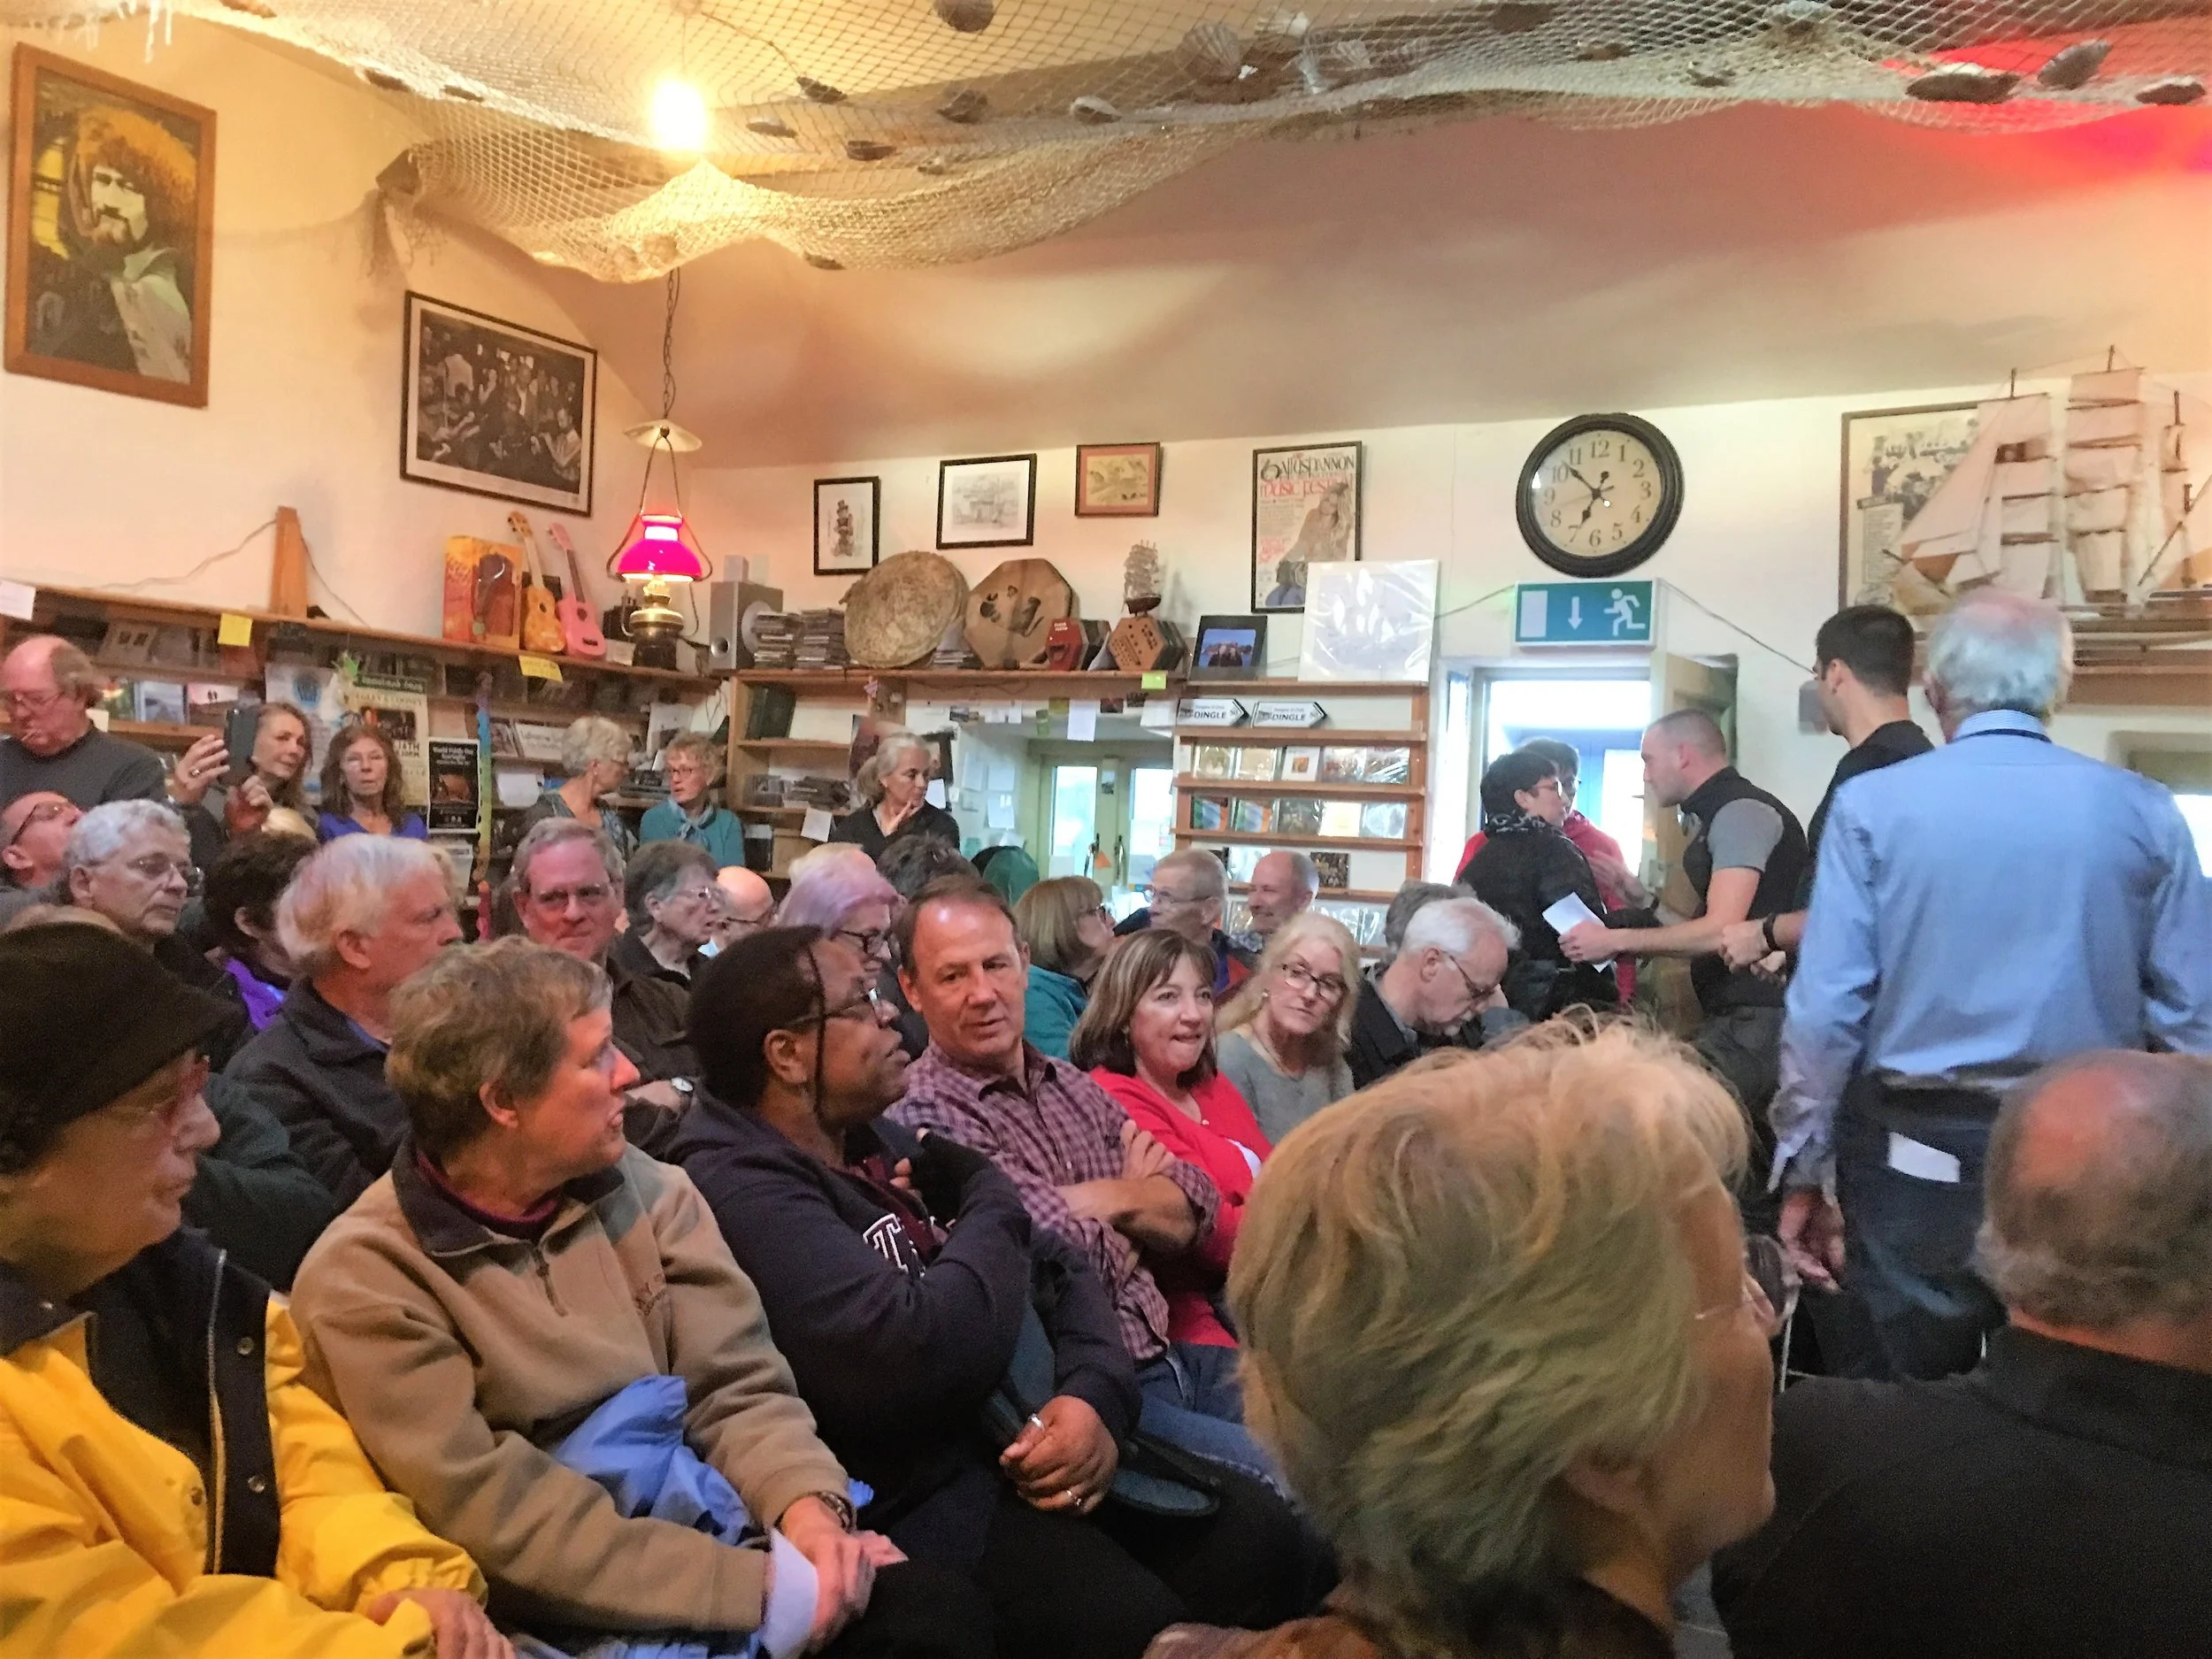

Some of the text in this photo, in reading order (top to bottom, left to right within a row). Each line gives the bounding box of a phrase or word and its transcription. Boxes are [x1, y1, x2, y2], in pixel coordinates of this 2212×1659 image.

[1569, 448, 1582, 465] 11
[1591, 440, 1610, 458] 12
[1618, 444, 1625, 462] 1
[1552, 465, 1570, 484] 10
[1632, 458, 1645, 479] 2
[1544, 489, 1555, 506] 9
[1640, 480, 1651, 500] 3
[1550, 509, 1562, 527] 8
[1630, 505, 1641, 524] 4
[1568, 525, 1581, 544] 7
[1589, 529, 1601, 547] 6
[1612, 523, 1623, 541] 5
[1194, 710, 1227, 719] DINGLE
